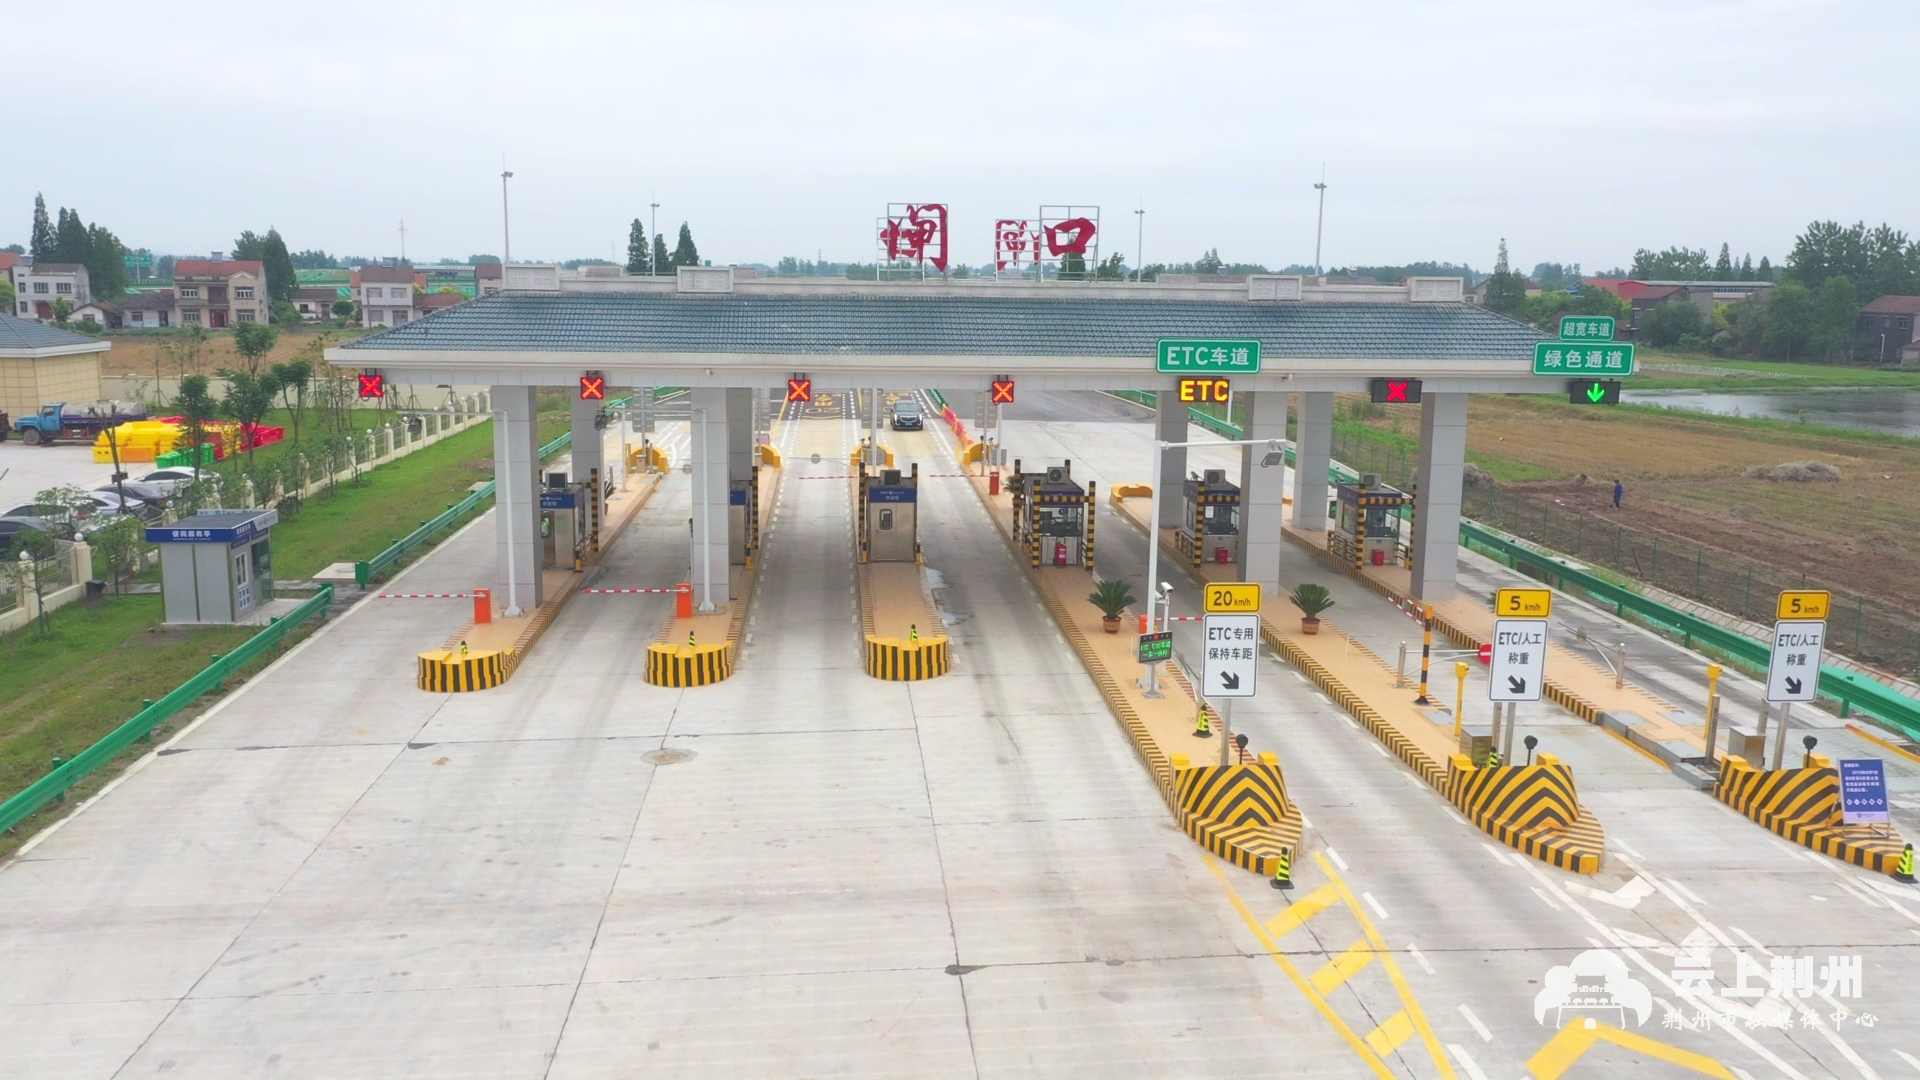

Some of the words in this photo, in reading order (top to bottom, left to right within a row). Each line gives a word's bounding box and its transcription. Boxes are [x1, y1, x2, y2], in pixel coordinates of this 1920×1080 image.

[1563, 322, 1611, 337] 超宽车道
[1167, 346, 1249, 366] ETC车道
[1543, 350, 1623, 369] 绿色通道
[1180, 380, 1229, 402] ETC
[172, 530, 211, 538] 便民服务亭
[1213, 591, 1233, 607] 20
[1234, 597, 1251, 607] km/h
[1510, 595, 1521, 611] 5
[1524, 603, 1541, 612] km/h
[1790, 598, 1802, 614] 5
[1498, 631, 1541, 645] ETC/人工
[1778, 633, 1819, 647] ETC/人工
[1208, 647, 1253, 660] 保持车距
[1508, 652, 1530, 665] 称重
[1786, 653, 1807, 666] 称重
